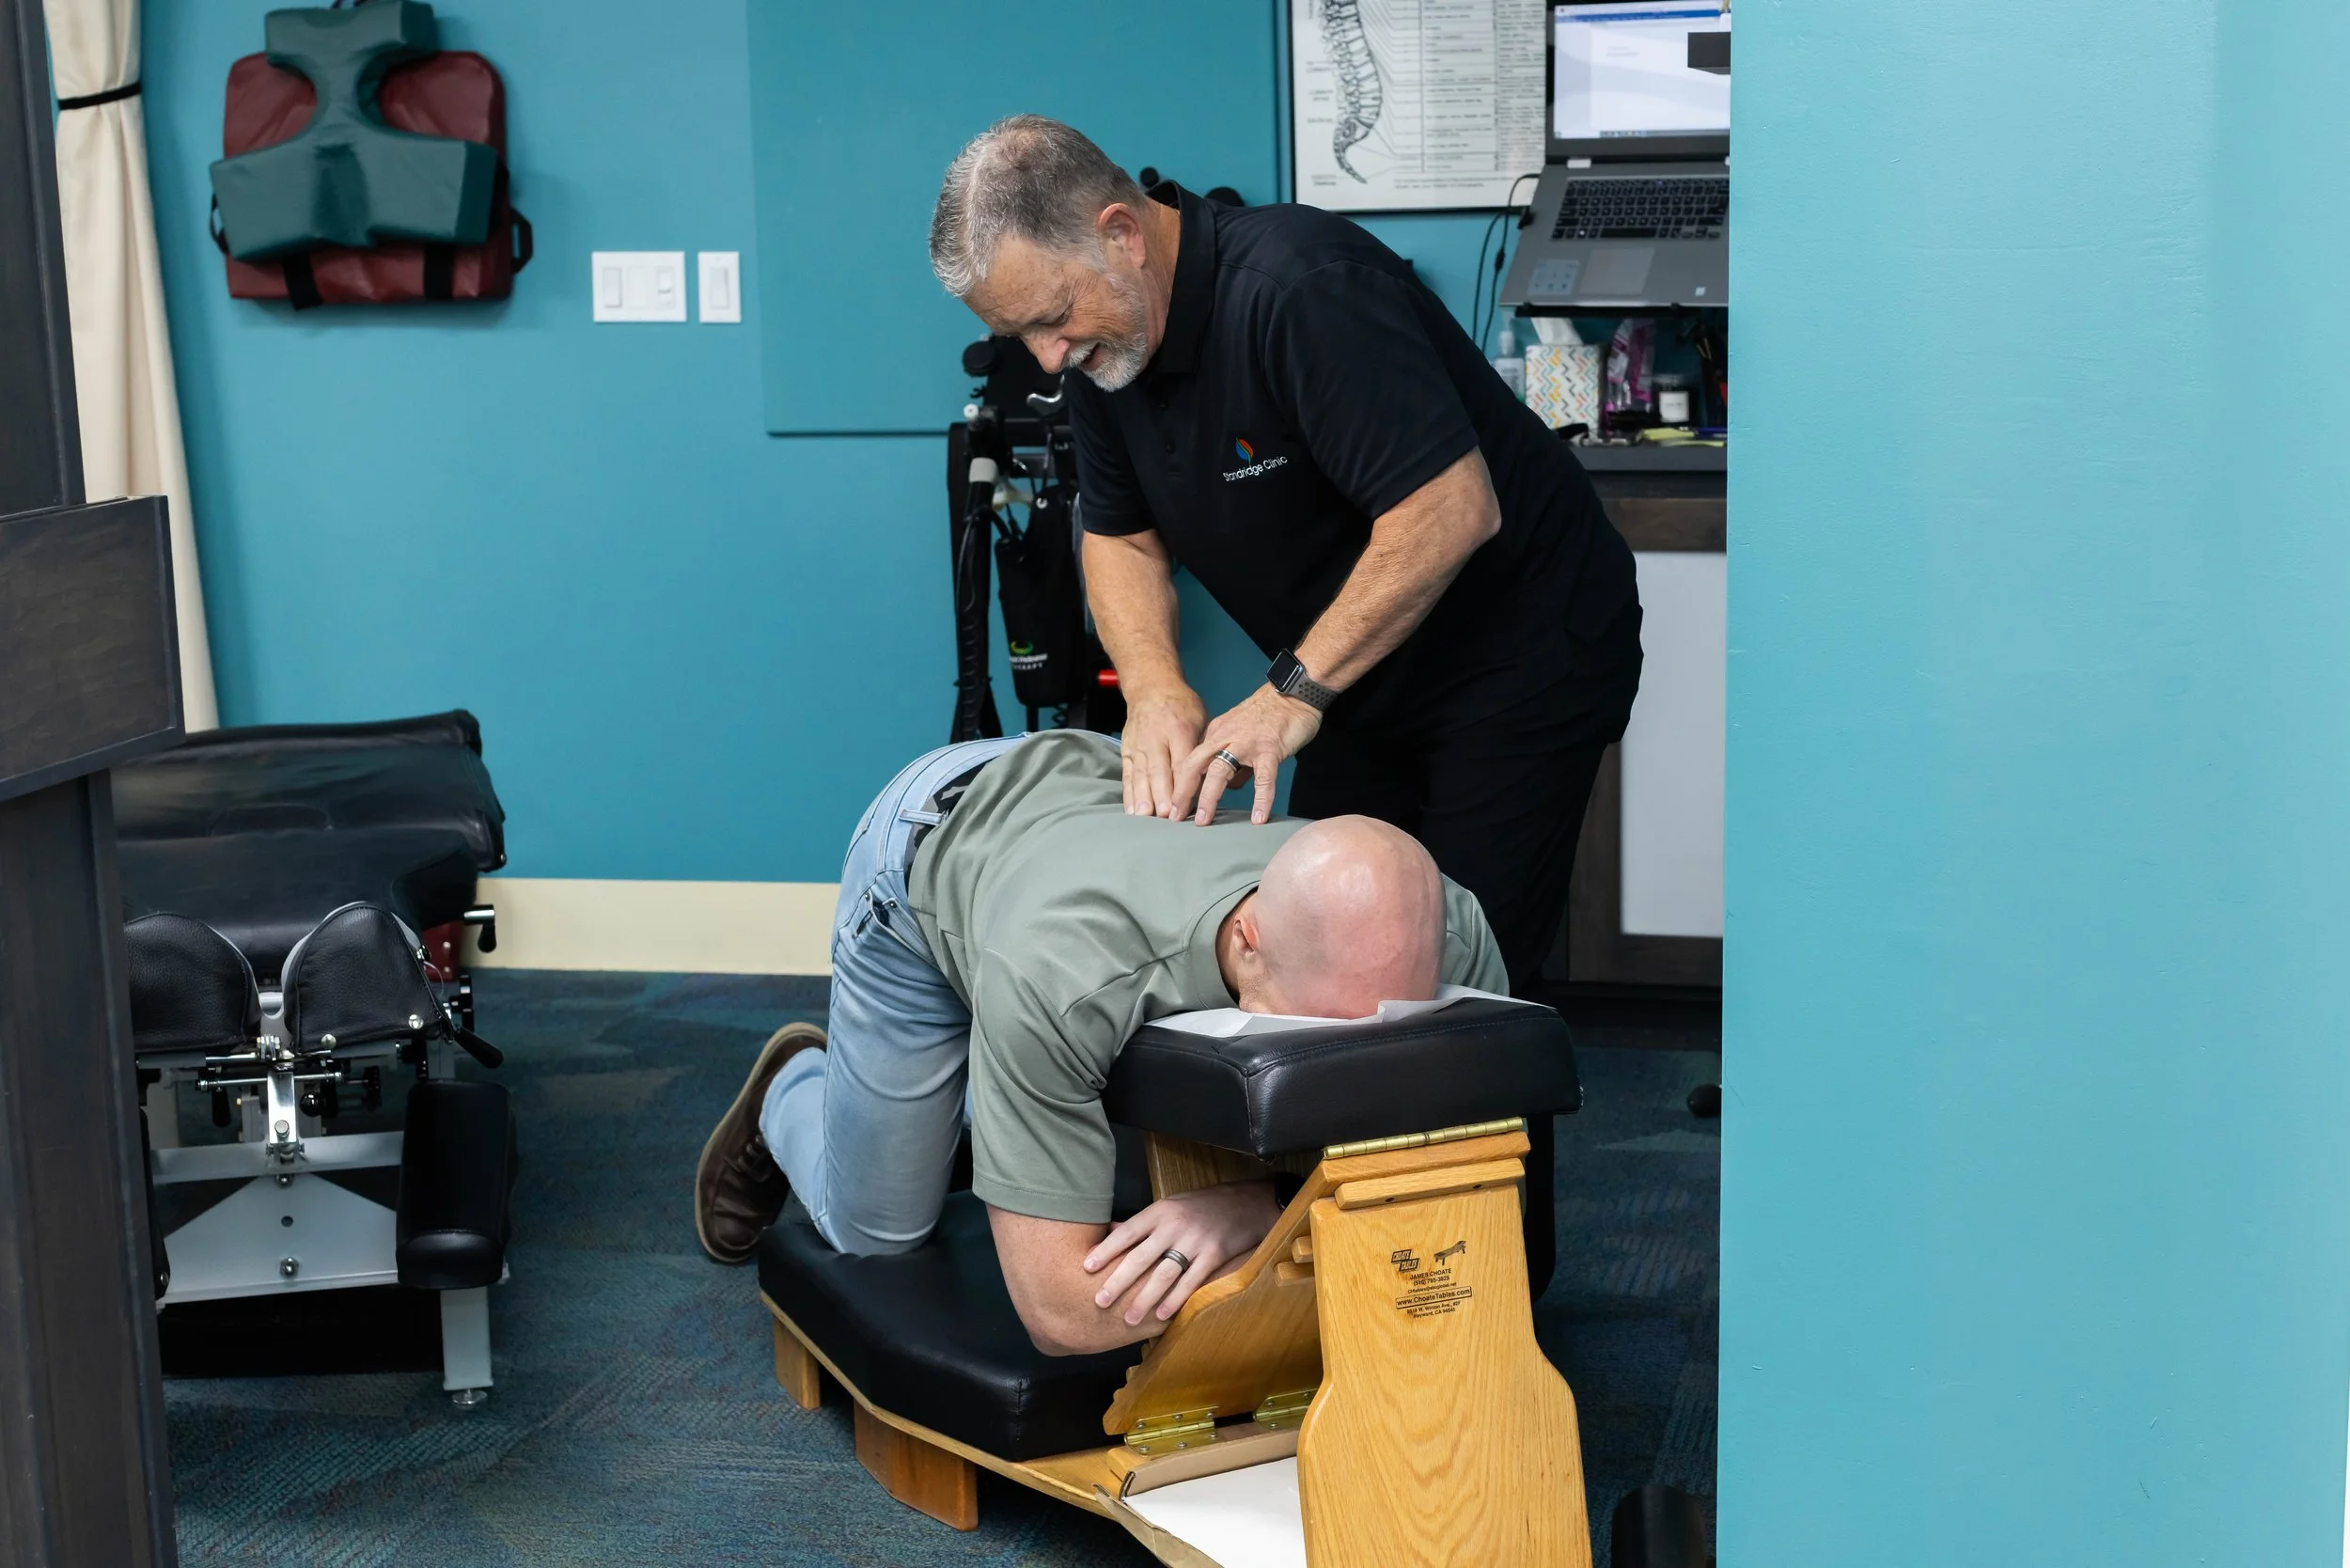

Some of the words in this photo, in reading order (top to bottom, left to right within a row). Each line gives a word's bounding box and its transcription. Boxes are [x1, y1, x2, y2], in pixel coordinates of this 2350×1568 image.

[1262, 456, 1288, 470] Clinic
[1429, 1268, 1452, 1277] CHOATE
[1397, 1289, 1470, 1305] www.ChoateTables.com
